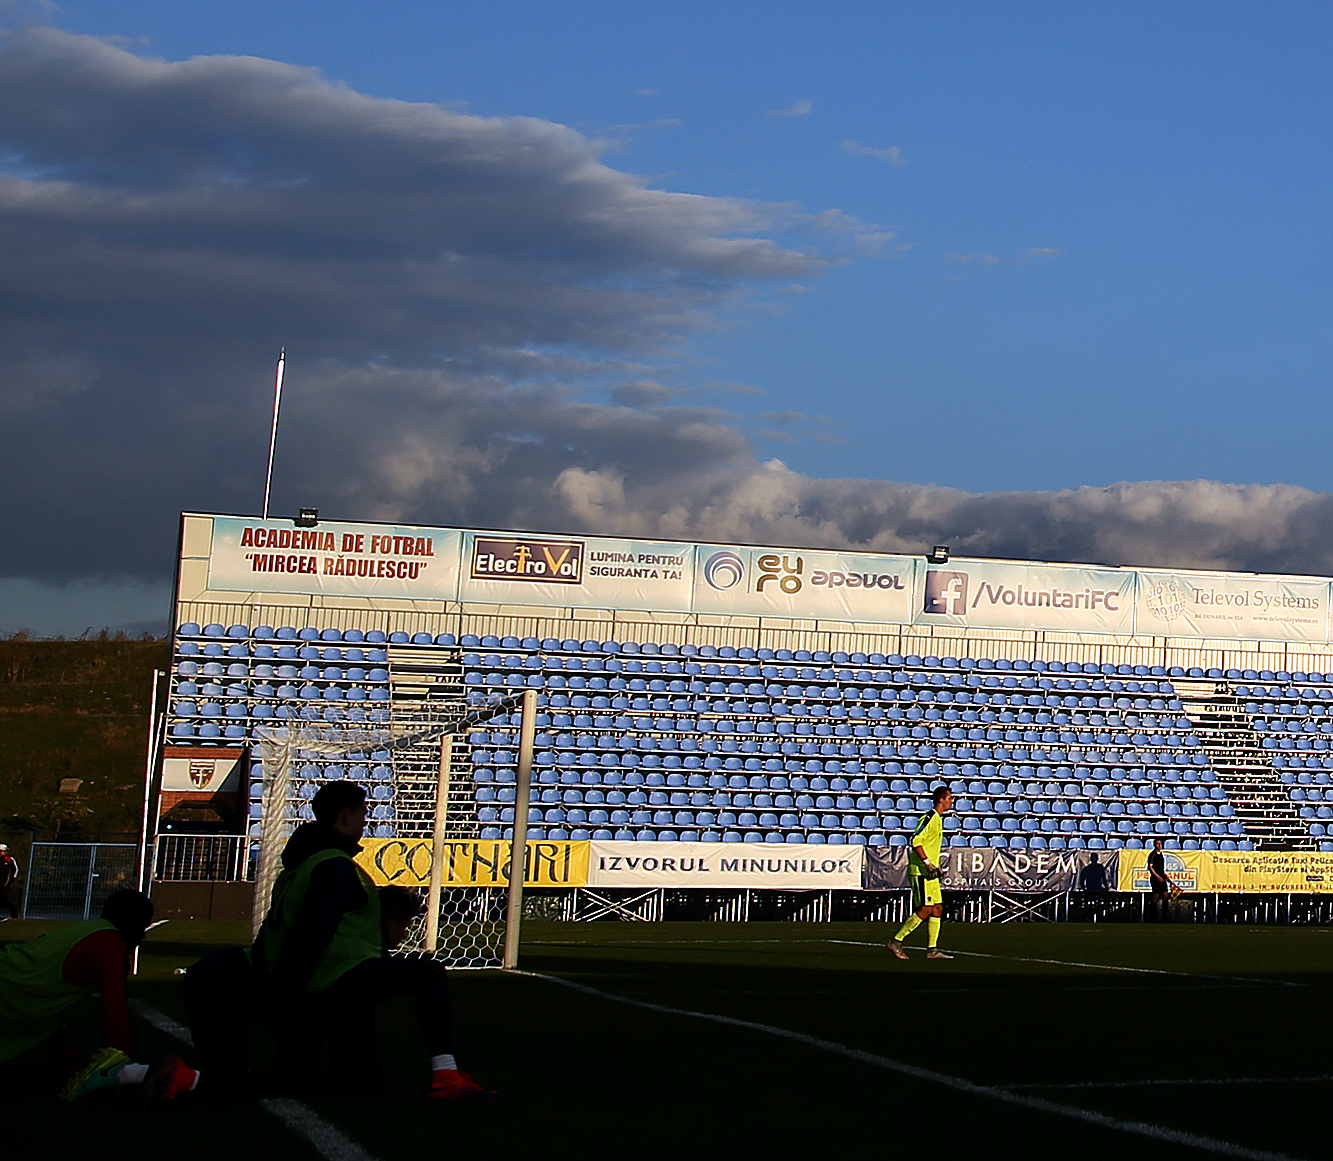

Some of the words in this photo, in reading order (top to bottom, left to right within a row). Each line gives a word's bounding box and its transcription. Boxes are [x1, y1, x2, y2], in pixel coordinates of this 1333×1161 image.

[241, 528, 335, 554] ACADEMIA
[343, 534, 364, 553] DE
[371, 535, 434, 556] FOTBAL
[590, 551, 634, 564] LUMINA
[638, 555, 684, 566] PENTRU
[589, 567, 658, 579] SIGURANTA
[663, 570, 683, 580] TA!
[1192, 588, 1249, 607] Televol
[1253, 589, 1320, 611] Systems
[599, 856, 710, 872] IZVORUL
[720, 858, 853, 874] MINUNILOR
[939, 852, 1077, 873] CIBADEM
[944, 877, 1000, 886] OSPITALS
[1008, 877, 1049, 888] GROUP
